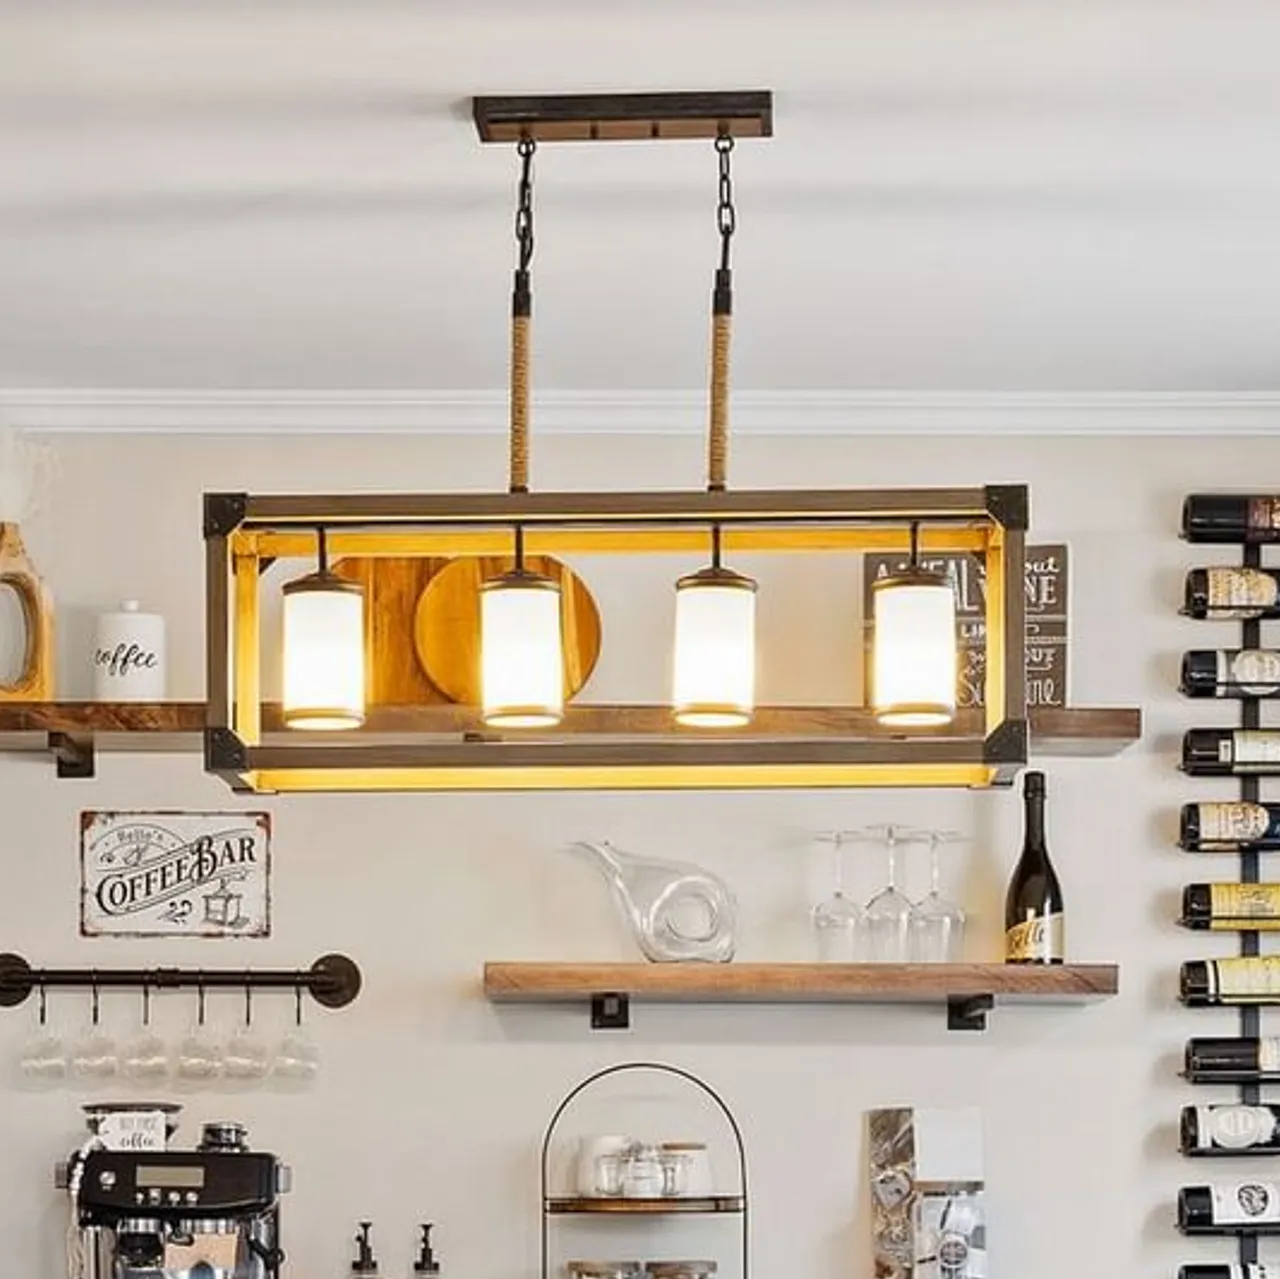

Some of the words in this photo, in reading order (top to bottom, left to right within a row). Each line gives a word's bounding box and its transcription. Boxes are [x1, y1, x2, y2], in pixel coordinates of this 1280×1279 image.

[95, 642, 158, 677] coffee
[95, 856, 191, 915] COFFEE
[188, 834, 257, 887] BAR
